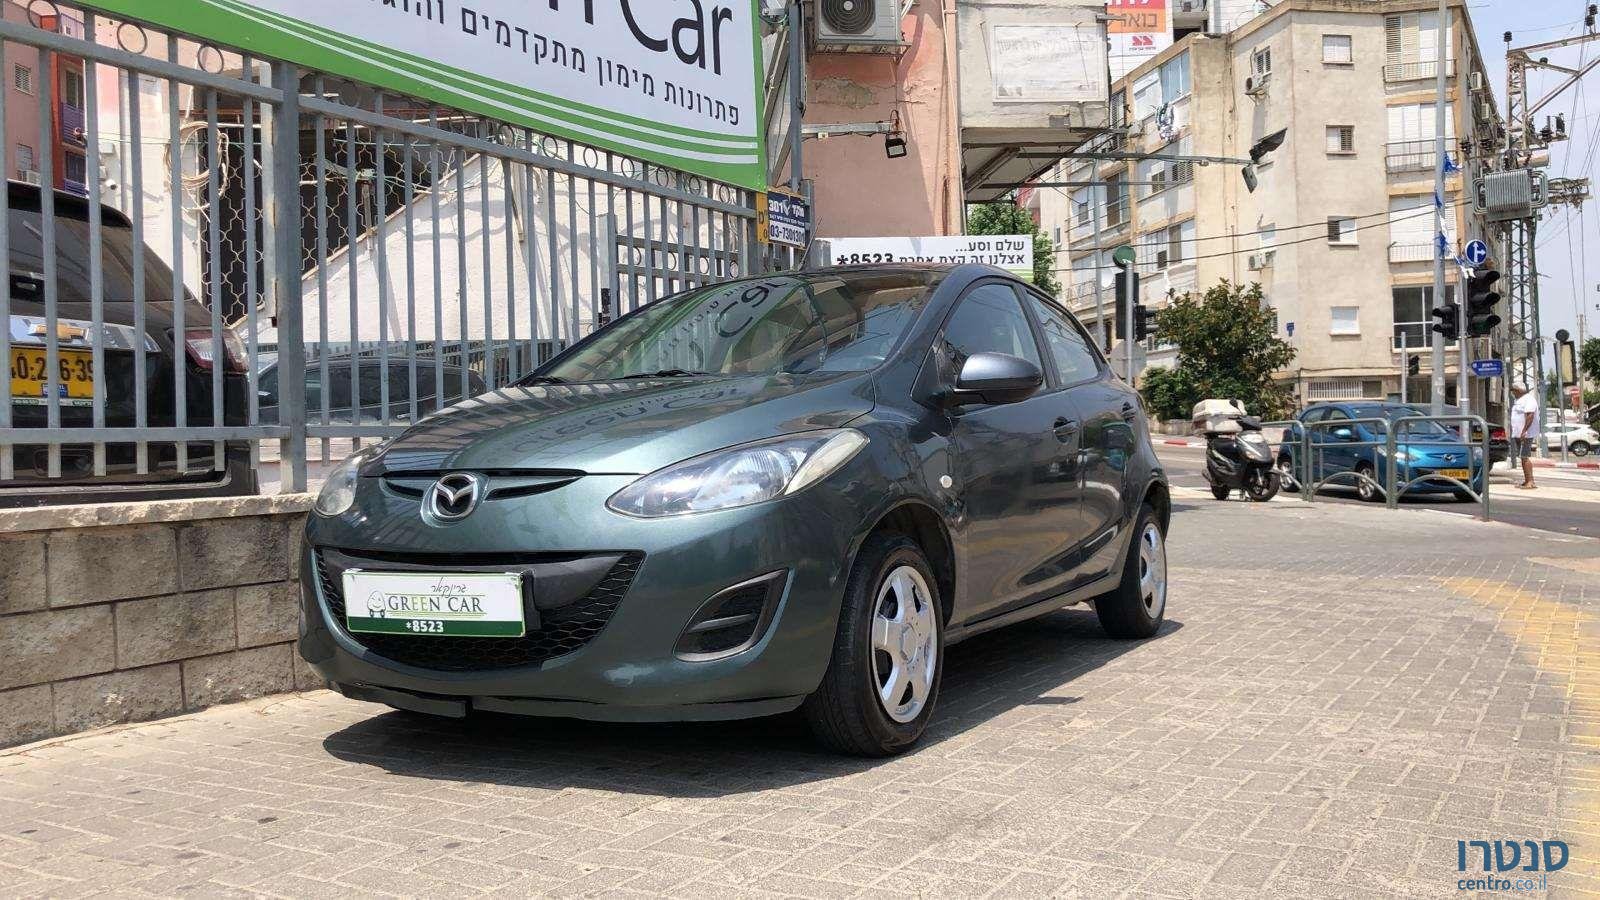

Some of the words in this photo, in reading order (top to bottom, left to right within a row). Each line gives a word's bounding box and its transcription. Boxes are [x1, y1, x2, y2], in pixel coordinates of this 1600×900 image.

[461, 7, 586, 74] מתקדמים
[597, 56, 655, 97] מימון
[664, 81, 739, 126] פתרונות
[995, 238, 1025, 251] שלם
[388, 595, 440, 612] GREEN
[447, 596, 484, 613] CAR
